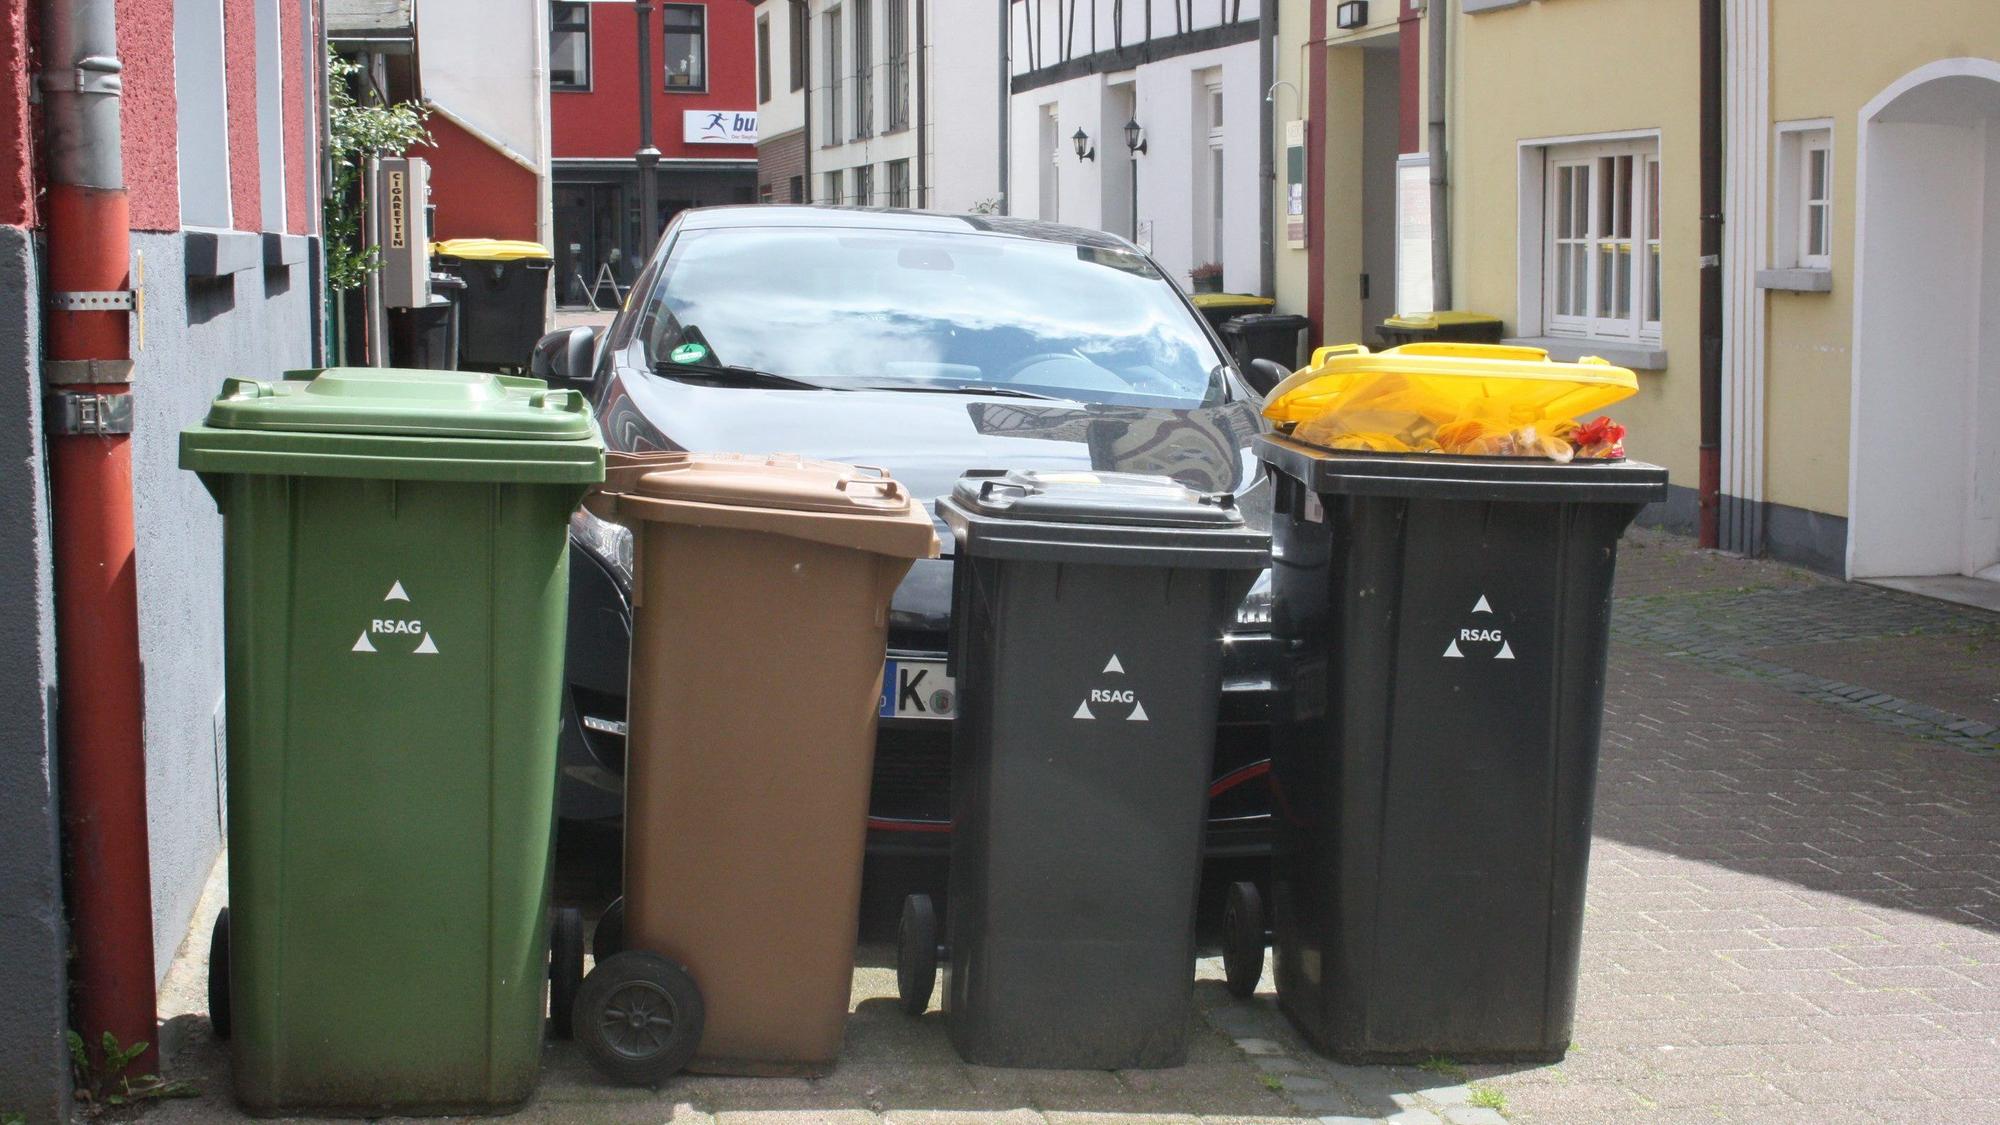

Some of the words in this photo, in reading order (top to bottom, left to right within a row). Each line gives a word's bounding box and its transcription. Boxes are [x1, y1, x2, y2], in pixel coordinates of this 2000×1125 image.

[733, 113, 758, 132] bu
[391, 173, 403, 246] CIGARETTEN
[372, 619, 421, 634] RSAG
[1461, 628, 1502, 642] RSAG
[899, 668, 928, 712] K
[1091, 689, 1134, 703] RSAG
